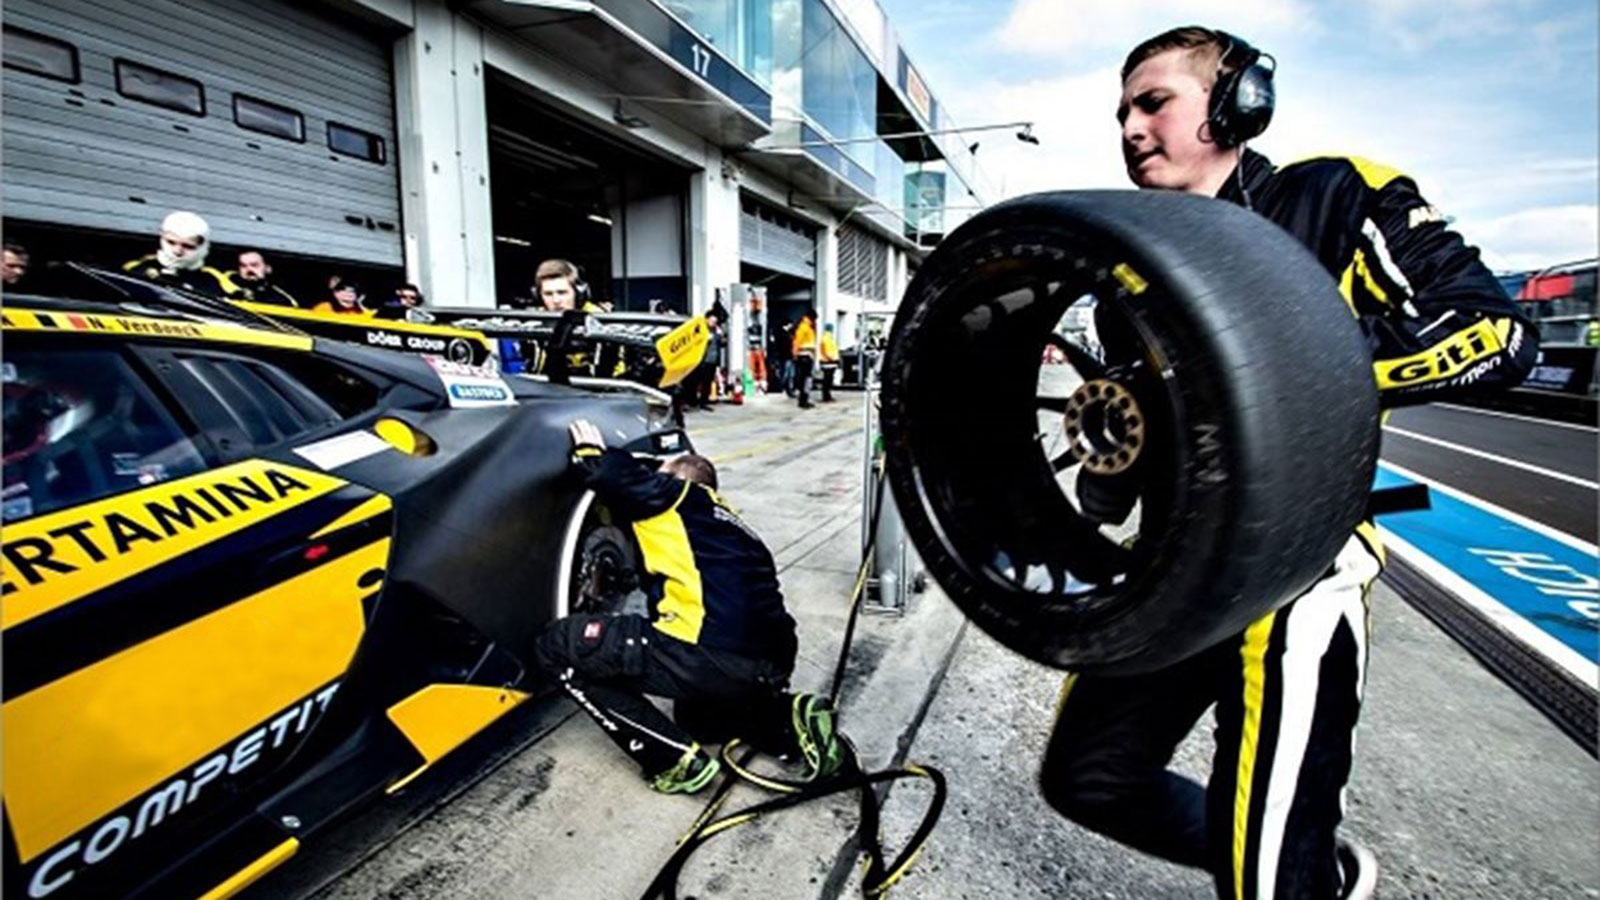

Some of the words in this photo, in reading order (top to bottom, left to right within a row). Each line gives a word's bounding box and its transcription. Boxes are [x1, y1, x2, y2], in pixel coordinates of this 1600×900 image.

[691, 44, 710, 77] 17
[1388, 331, 1486, 382] Giti
[28, 682, 341, 898] COMPETIT
